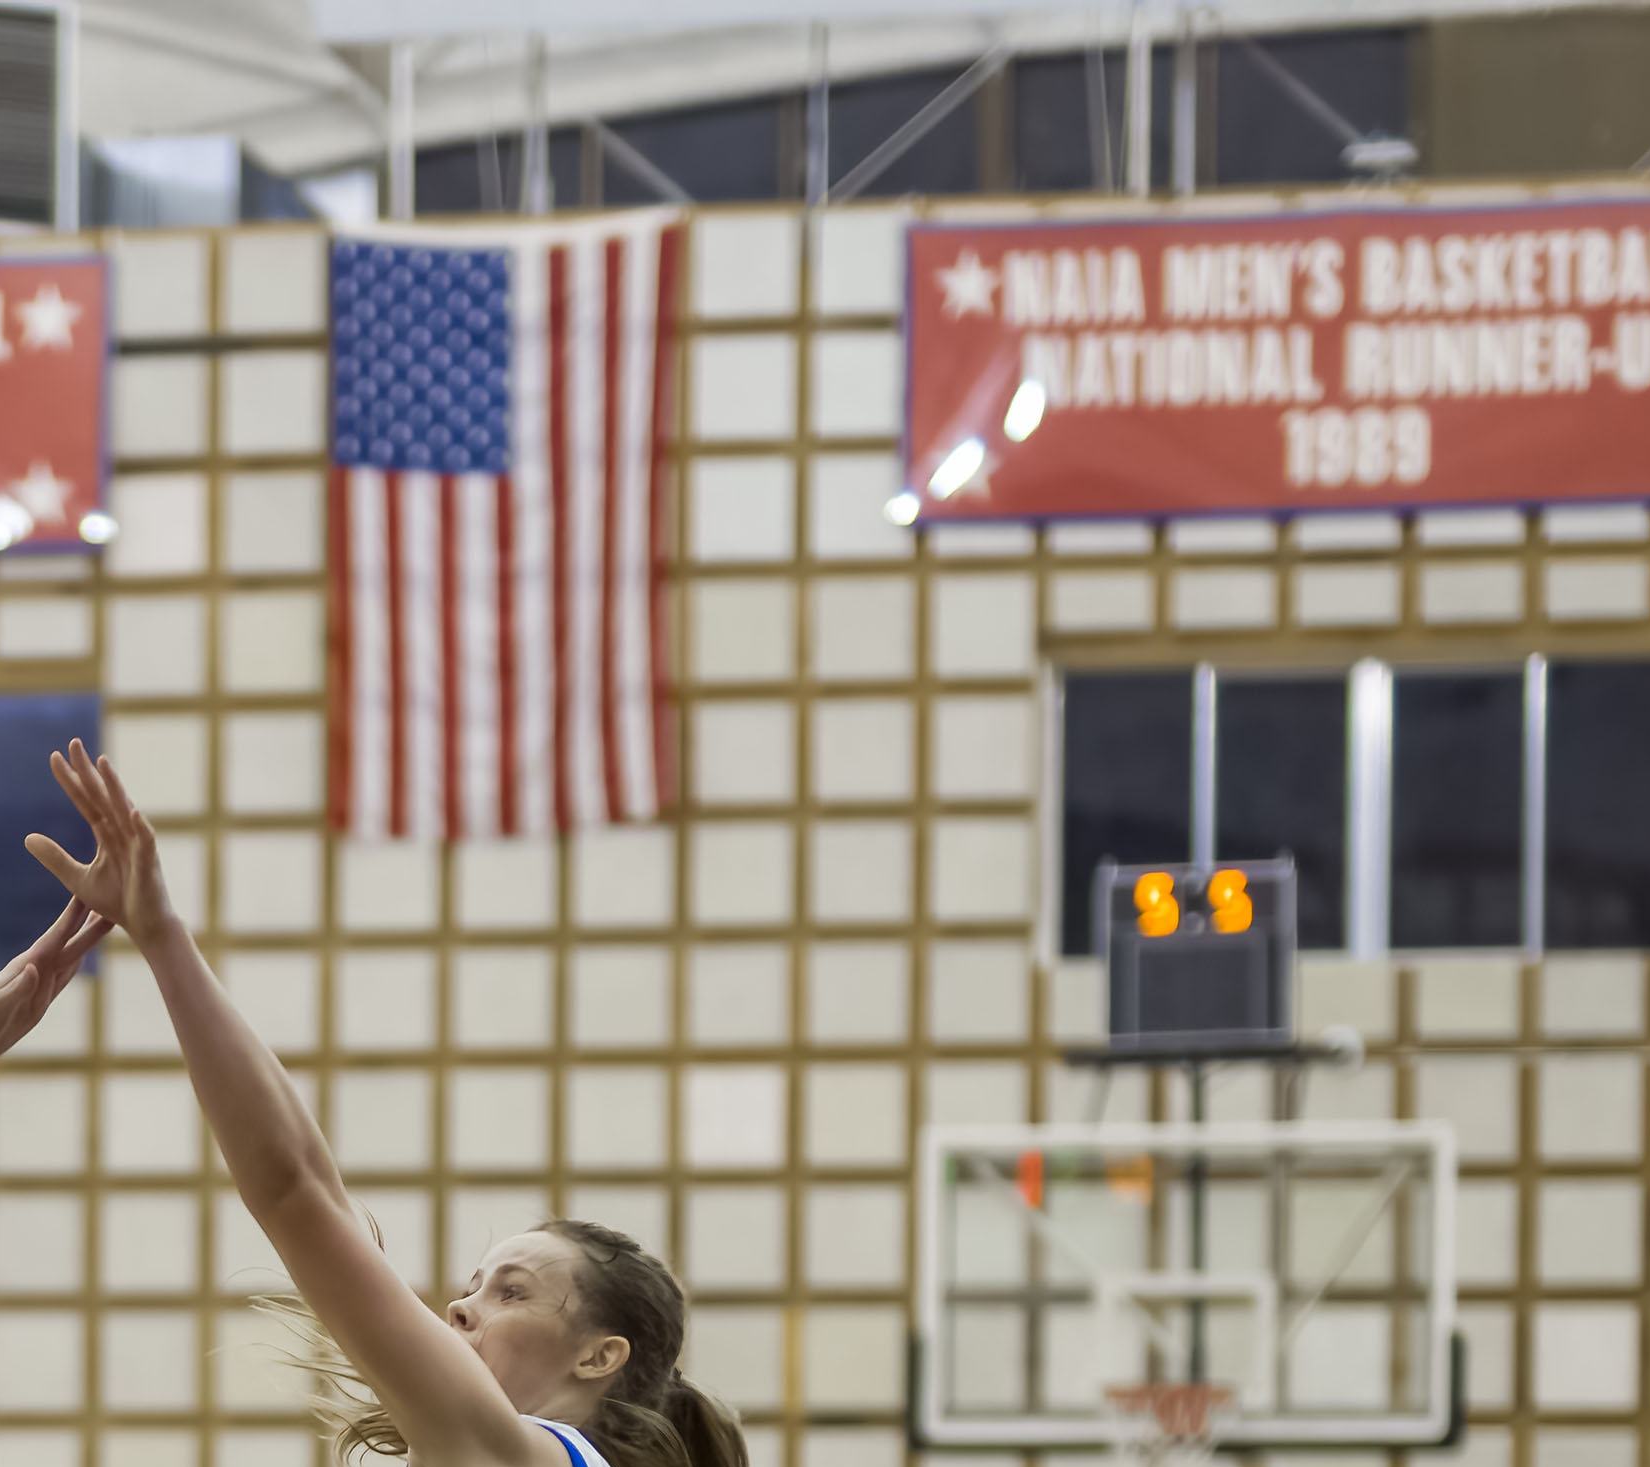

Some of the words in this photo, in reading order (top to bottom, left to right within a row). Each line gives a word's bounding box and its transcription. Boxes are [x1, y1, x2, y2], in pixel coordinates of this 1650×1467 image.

[1004, 250, 1146, 324] NAIA
[1162, 238, 1343, 319] MEN'S
[1022, 325, 1324, 407] NATIONAL
[1284, 408, 1431, 484] 1989
